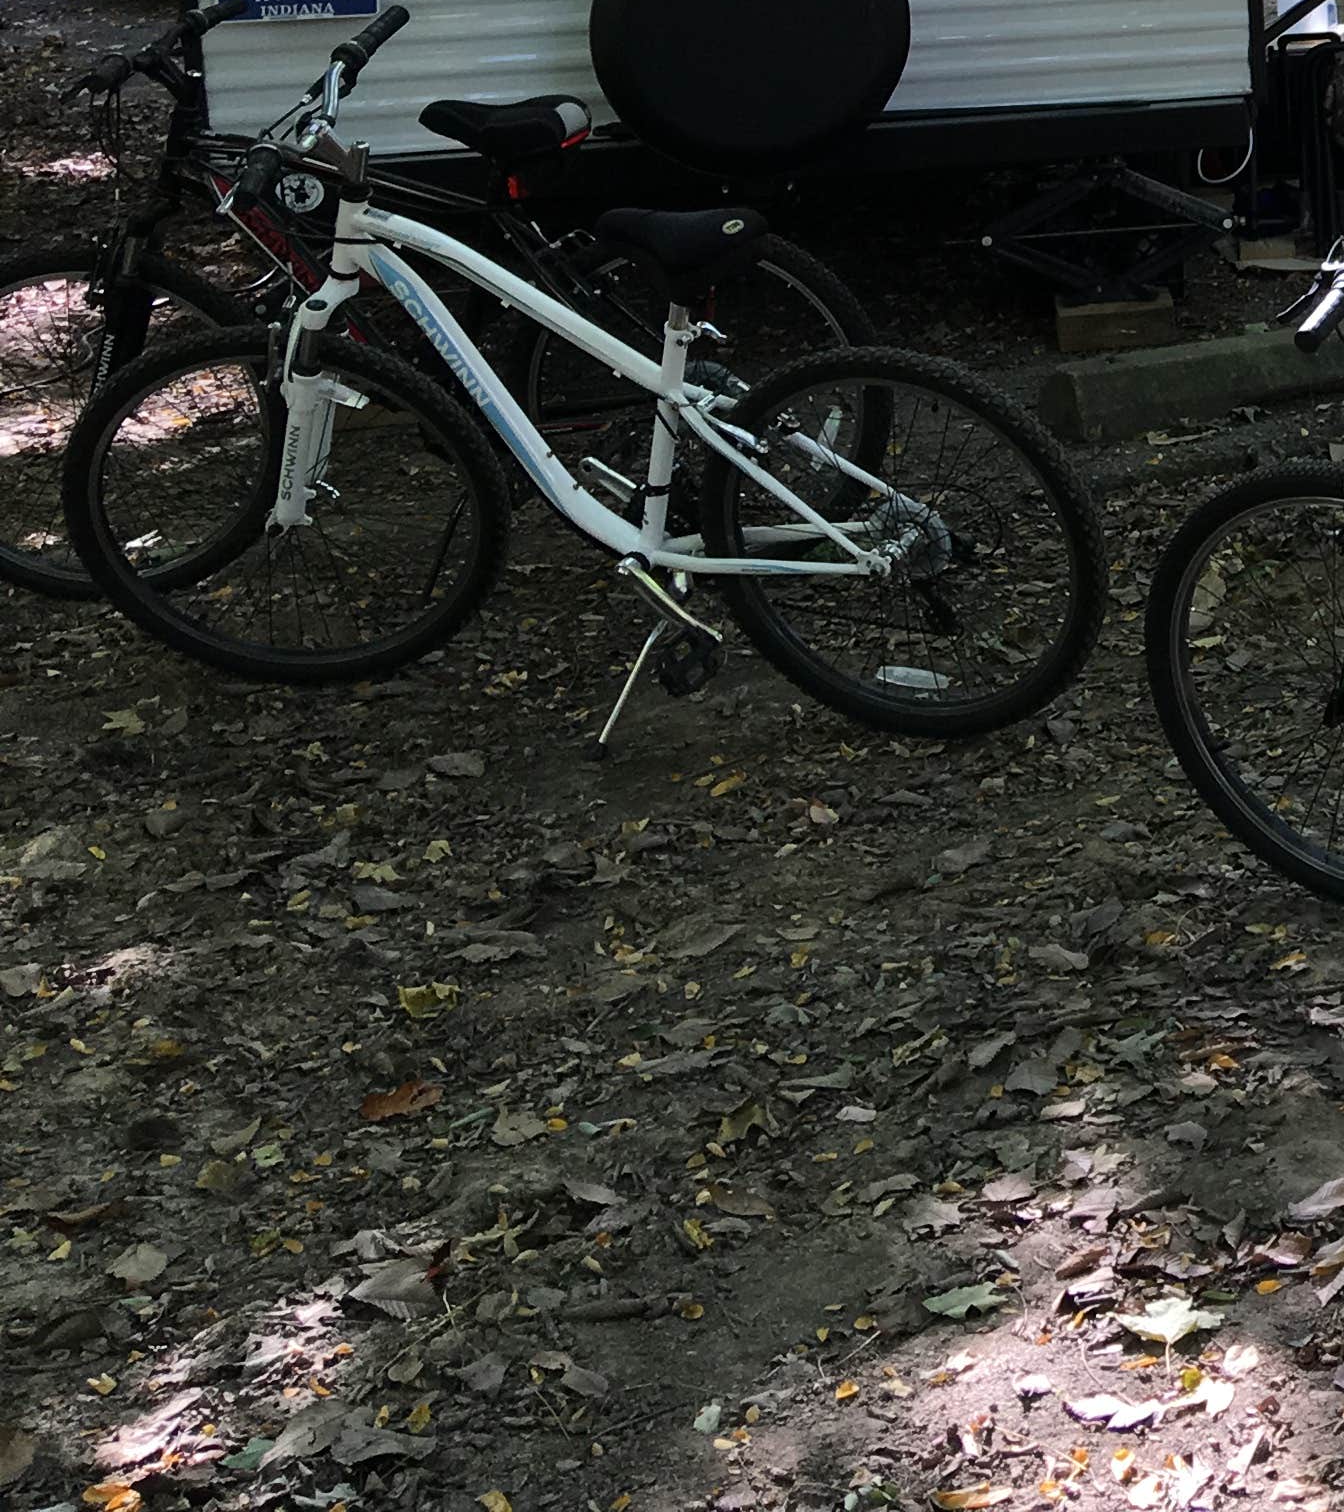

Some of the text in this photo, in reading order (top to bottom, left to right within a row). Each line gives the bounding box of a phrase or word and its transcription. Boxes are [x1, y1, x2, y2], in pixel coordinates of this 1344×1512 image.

[260, 2, 335, 17] INDIANA
[388, 279, 492, 408] SCHWINN
[281, 424, 301, 501] SCHWINN
